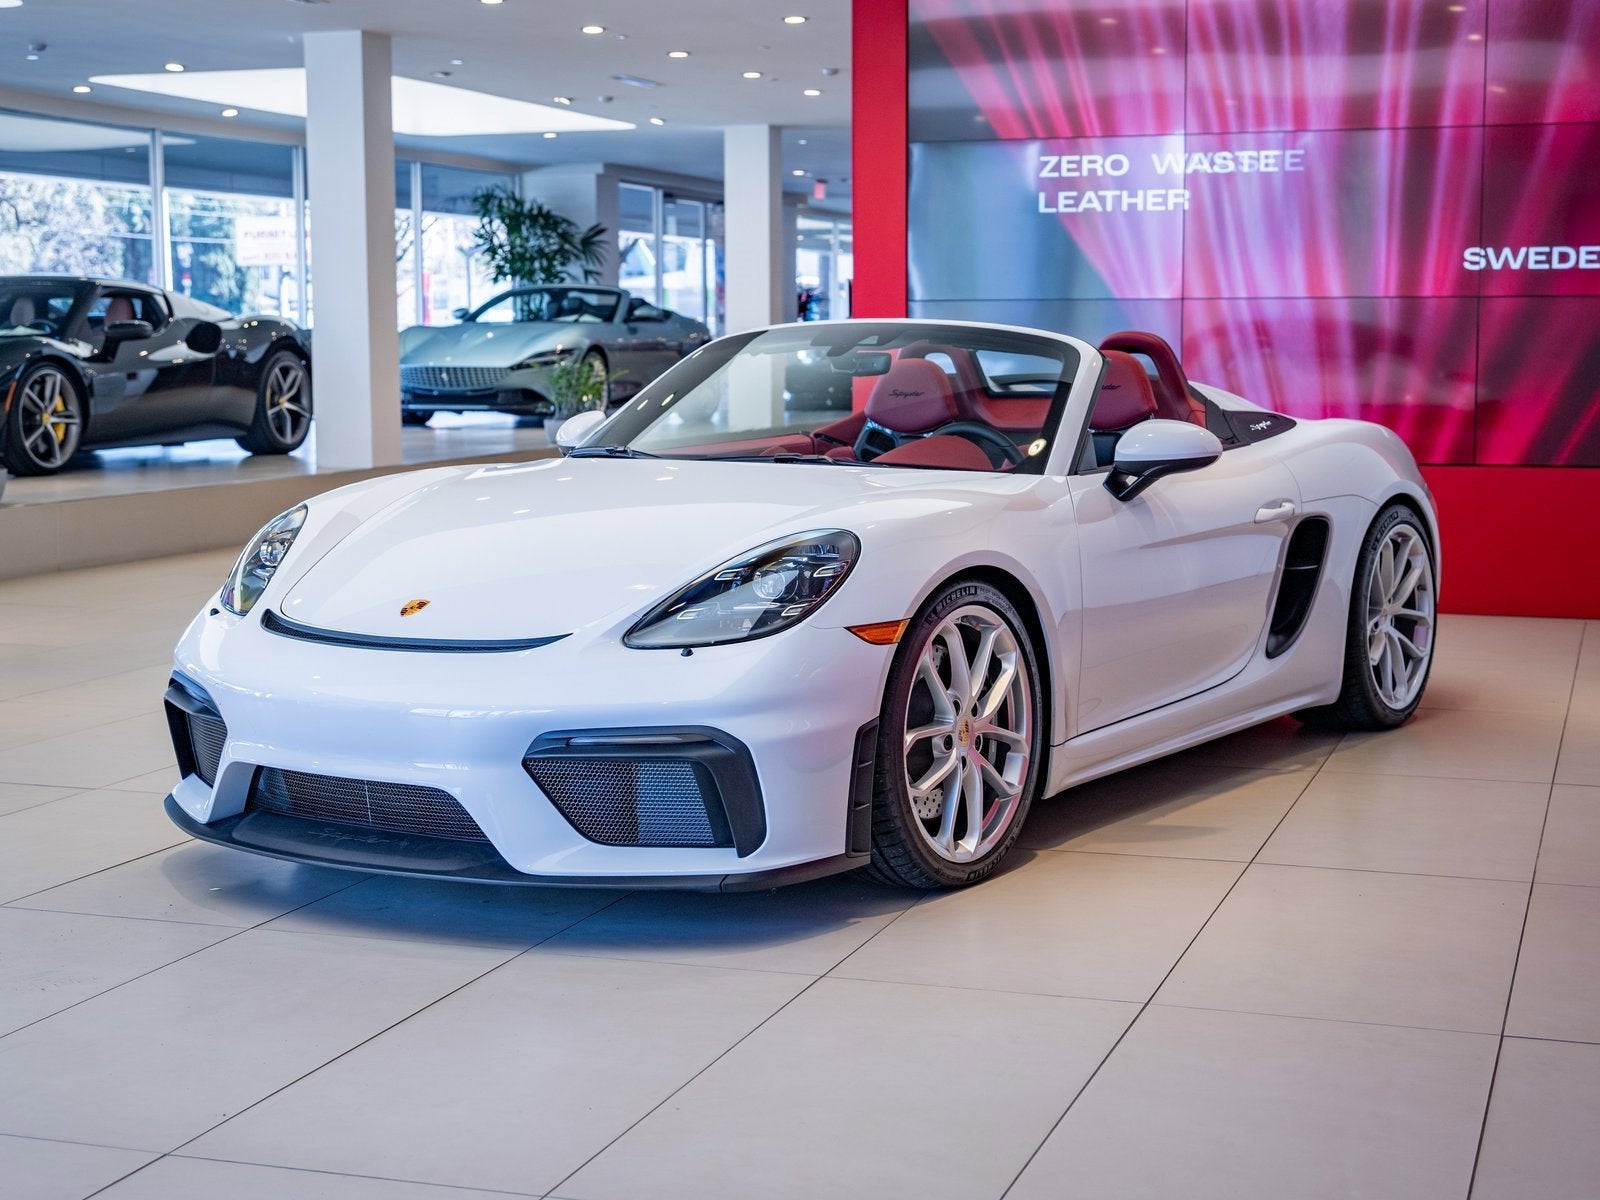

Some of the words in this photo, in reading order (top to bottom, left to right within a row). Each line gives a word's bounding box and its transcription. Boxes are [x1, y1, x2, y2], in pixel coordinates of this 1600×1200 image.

[1039, 154, 1129, 177] ZERO
[1038, 189, 1190, 213] LEATHER
[888, 389, 925, 399] Spyder
[936, 586, 976, 613] MICHELIN
